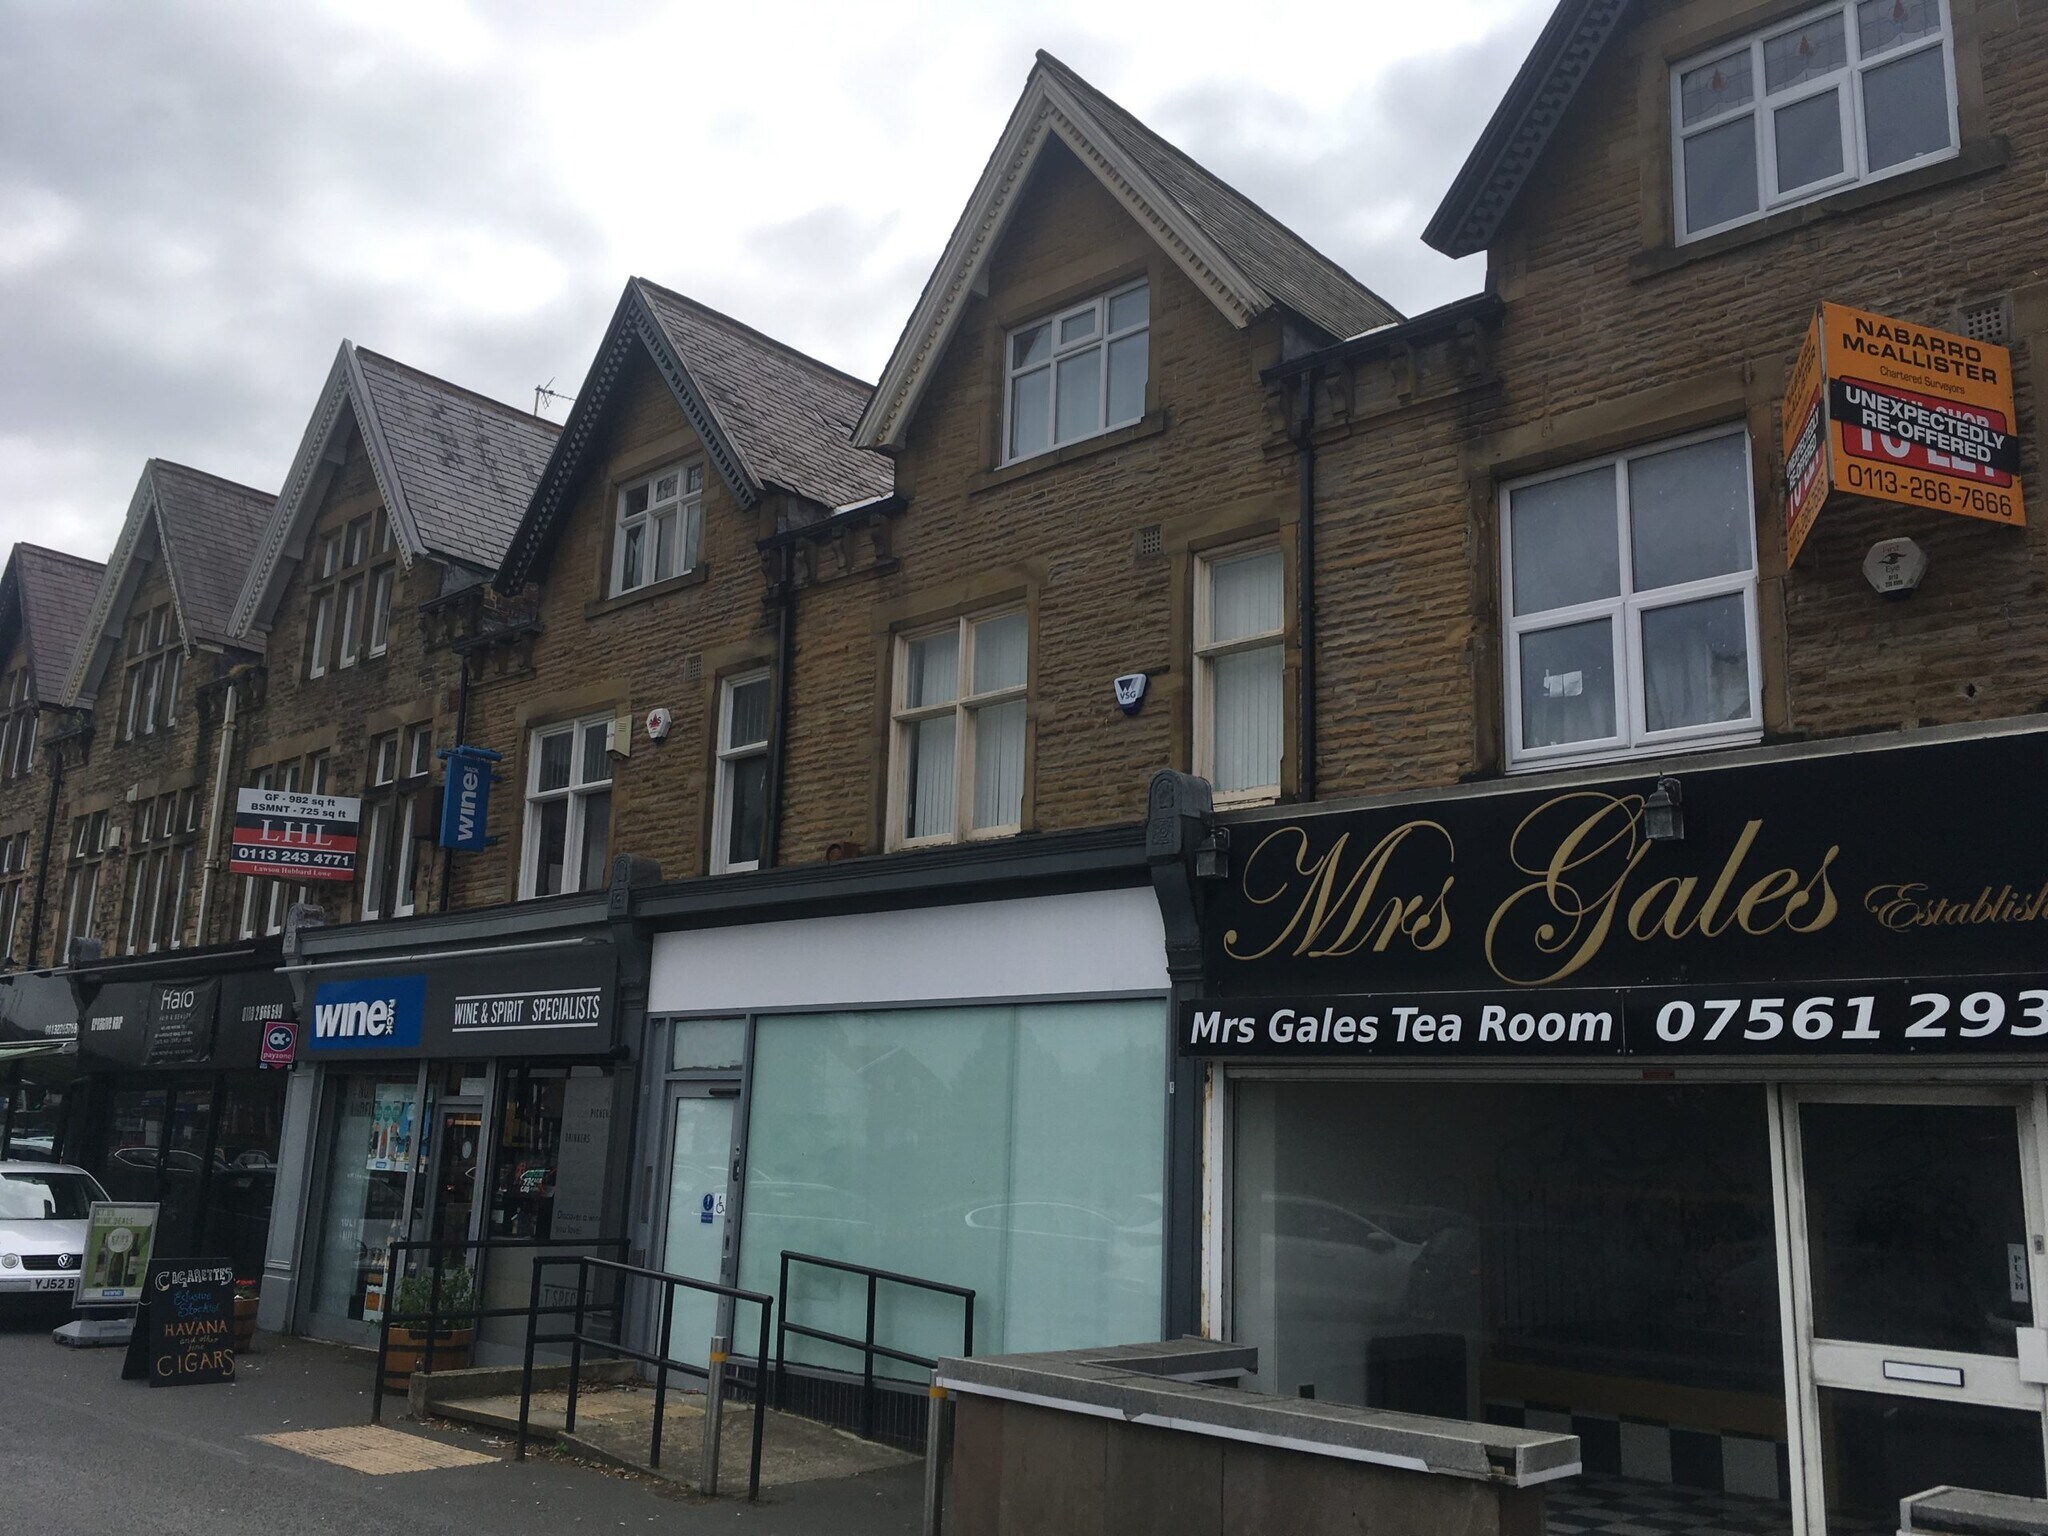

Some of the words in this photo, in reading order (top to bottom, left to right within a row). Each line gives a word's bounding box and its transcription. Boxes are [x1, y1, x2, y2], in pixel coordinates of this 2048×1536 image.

[1856, 318, 1982, 363] NABARRO
[1842, 333, 1998, 385] McALLISTER
[1880, 365, 1923, 385] Chartered
[1924, 376, 1965, 394] Surveyors
[1846, 385, 2005, 450] UNEXPECTEDLY
[1862, 408, 1992, 463] RE-OFFERED
[1847, 463, 2012, 517] 0113-266-7666
[1119, 690, 1136, 700] VSG
[250, 802, 290, 813] BSMNT
[299, 807, 319, 816] 725
[322, 809, 335, 818] sq
[337, 809, 346, 818] ft
[264, 793, 280, 802] GF
[288, 795, 309, 804] 982
[311, 798, 324, 807] sq
[327, 798, 336, 807] ft
[457, 772, 478, 841] wine
[260, 819, 332, 847] LHL
[238, 847, 277, 860] 0113
[281, 850, 309, 863] 243
[313, 853, 349, 866] 4771
[1224, 820, 1455, 961] Mrs
[1484, 791, 1840, 986] Gales
[161, 989, 194, 1010] Halo
[454, 1002, 479, 1024] WINE
[480, 1001, 488, 1024] &
[490, 999, 524, 1023] SPIRIT
[531, 994, 600, 1022] SPECIALISTS
[315, 999, 388, 1038] wine
[385, 998, 396, 1035] RACK
[1190, 1011, 1255, 1044] Mrs
[1268, 1008, 1379, 1043] Gales
[1391, 1008, 1462, 1043] Tea
[1479, 1004, 1618, 1042] Room
[1656, 994, 1882, 1042] 07561
[1904, 989, 2048, 1039] 293
[35, 1278, 65, 1290] YJ52
[164, 1319, 228, 1337] HAVANA
[157, 1348, 235, 1377] CIGARS
